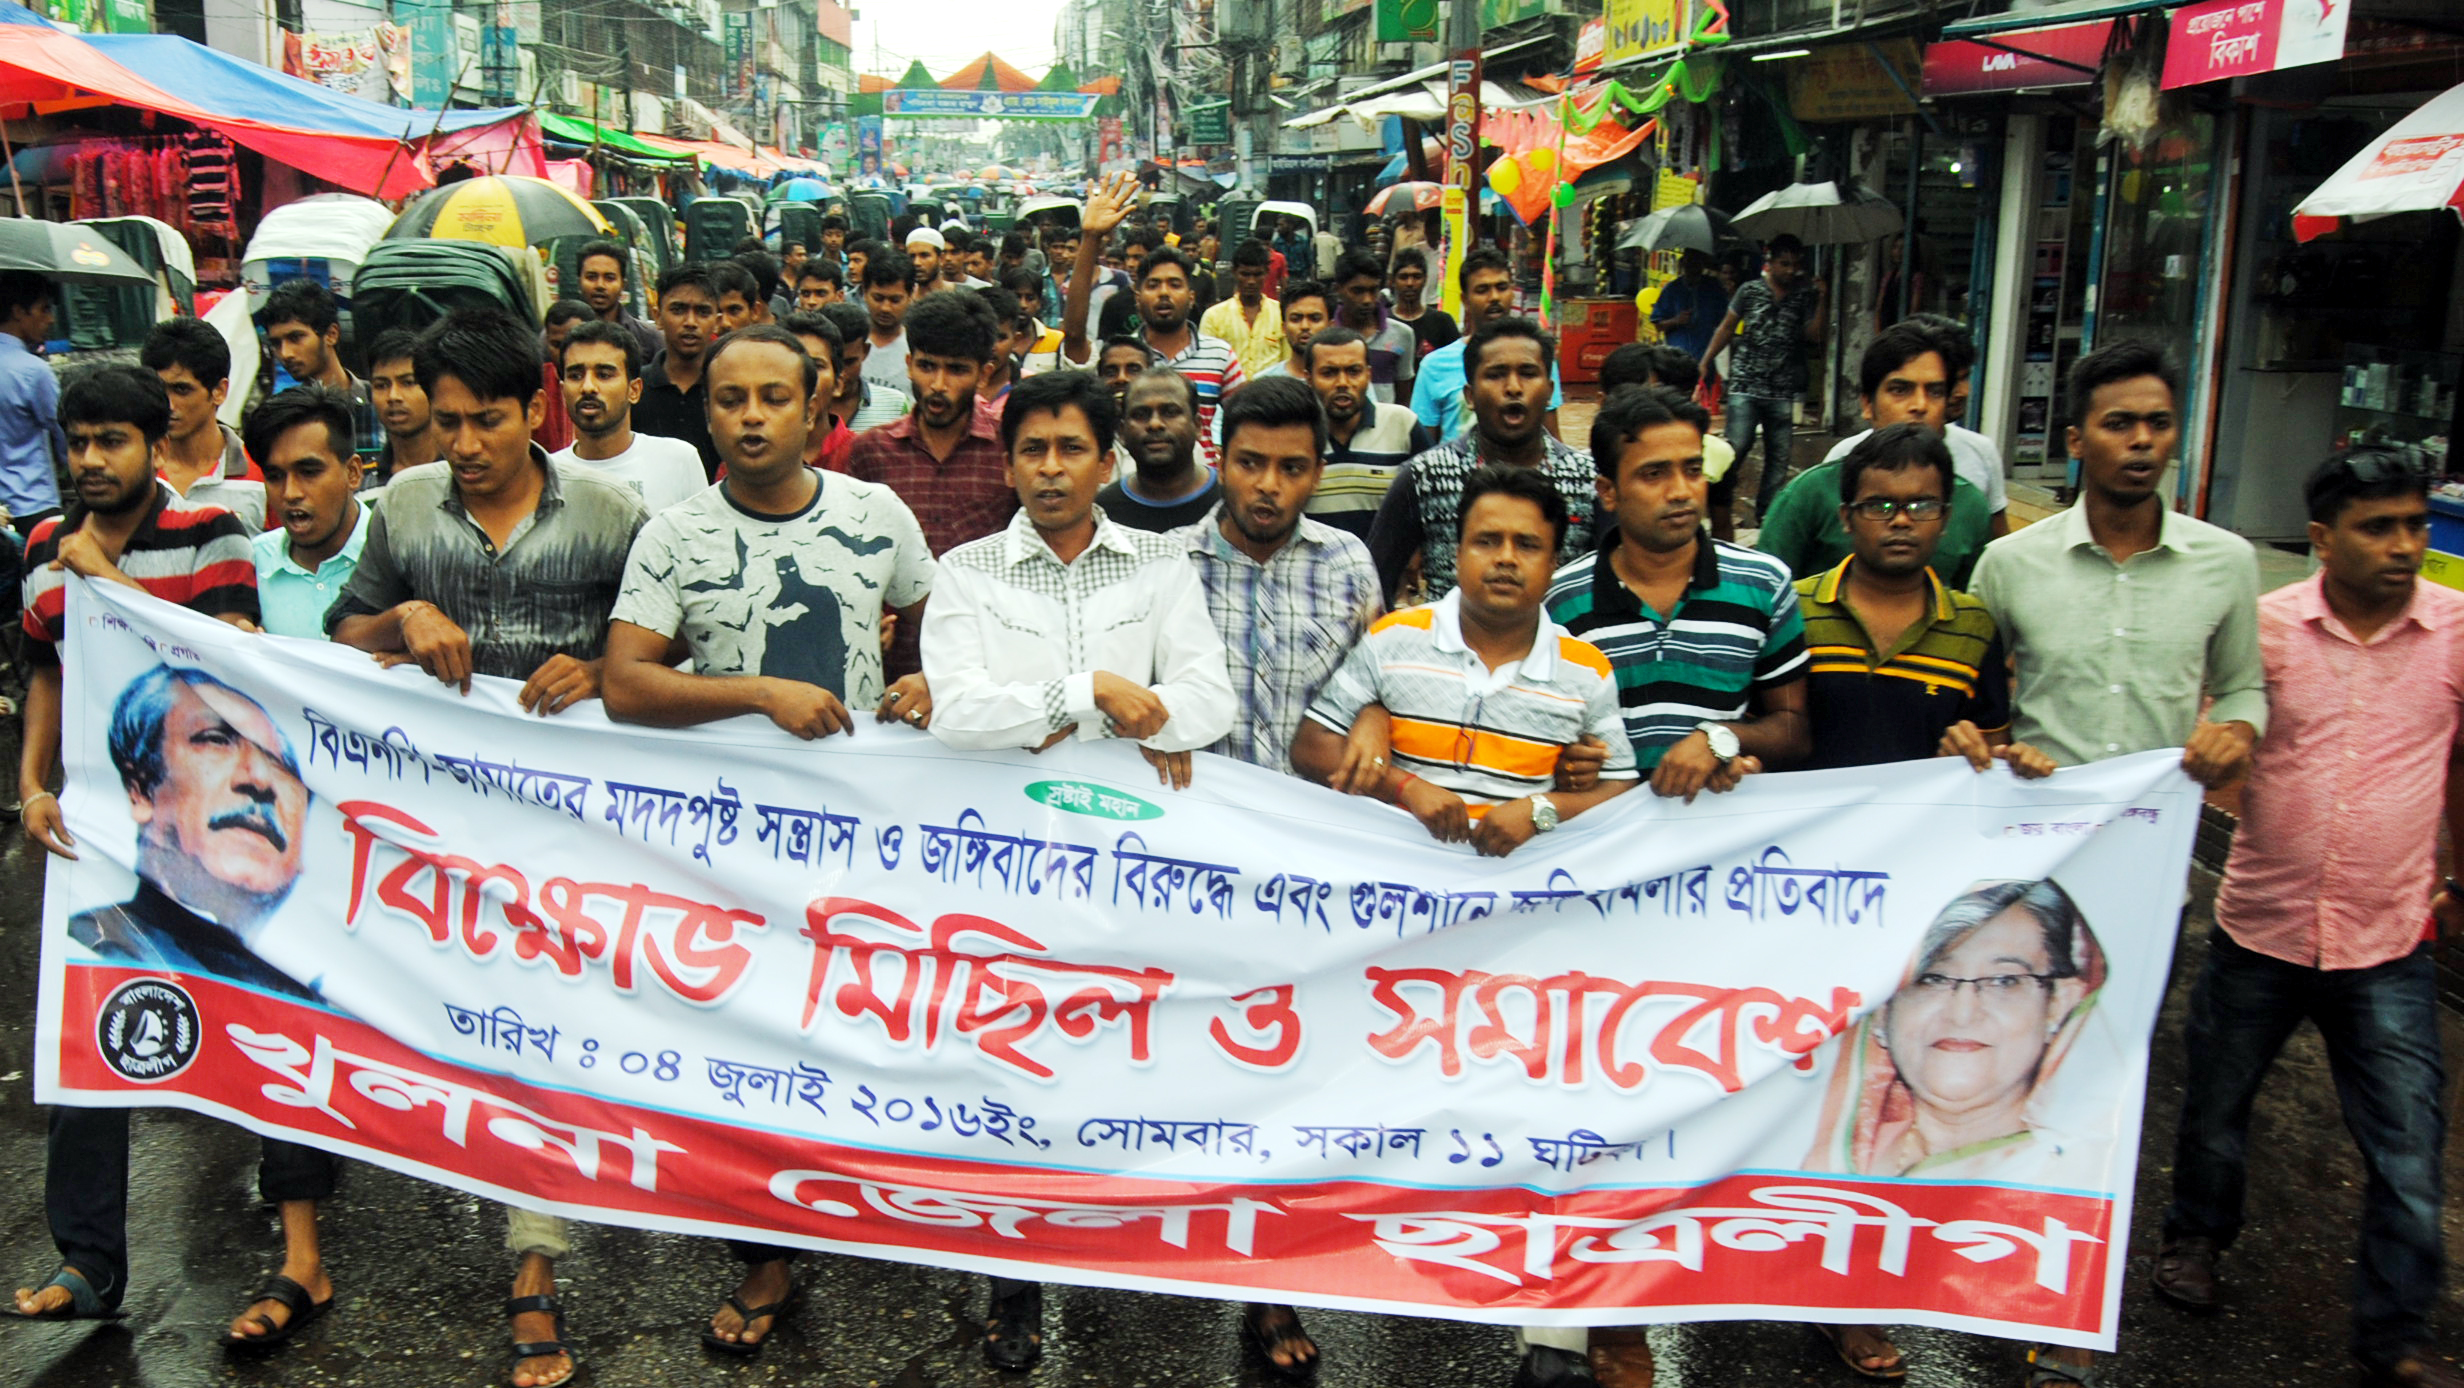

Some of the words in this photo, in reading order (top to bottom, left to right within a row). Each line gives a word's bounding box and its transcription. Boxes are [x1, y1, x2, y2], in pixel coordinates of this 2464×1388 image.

[1982, 53, 2017, 72] LAVA
[2208, 31, 2262, 70] বিকাশ
[604, 776, 741, 867] মদদপুষ্ট
[755, 803, 859, 870] সন্ত্রাস
[876, 824, 901, 871] ও
[920, 808, 1098, 902] জঙ্গিবাদের
[1112, 831, 1240, 921] বিরুদ্ধে
[1254, 872, 1332, 934] এবং
[1350, 882, 1498, 939] গুলশানে
[1725, 845, 1889, 928] প্রতিবাদে
[1098, 793, 1142, 818] মহান
[337, 800, 766, 1001] বিক্ষোভ
[800, 897, 1174, 1078] মিছিল
[1209, 983, 1301, 1066] ও
[1366, 966, 1861, 1093] সমাবেশ
[225, 1023, 688, 1193] খুলনা
[769, 1169, 1289, 1257] জেলা
[1340, 1185, 2106, 1295] ছাত্রলীগ
[444, 1002, 561, 1062] তারিখ
[620, 1050, 682, 1082] ০৪
[705, 1061, 833, 1120] জুলাই
[1293, 1123, 1427, 1162] সকাল
[1447, 1128, 1504, 1169] ১১
